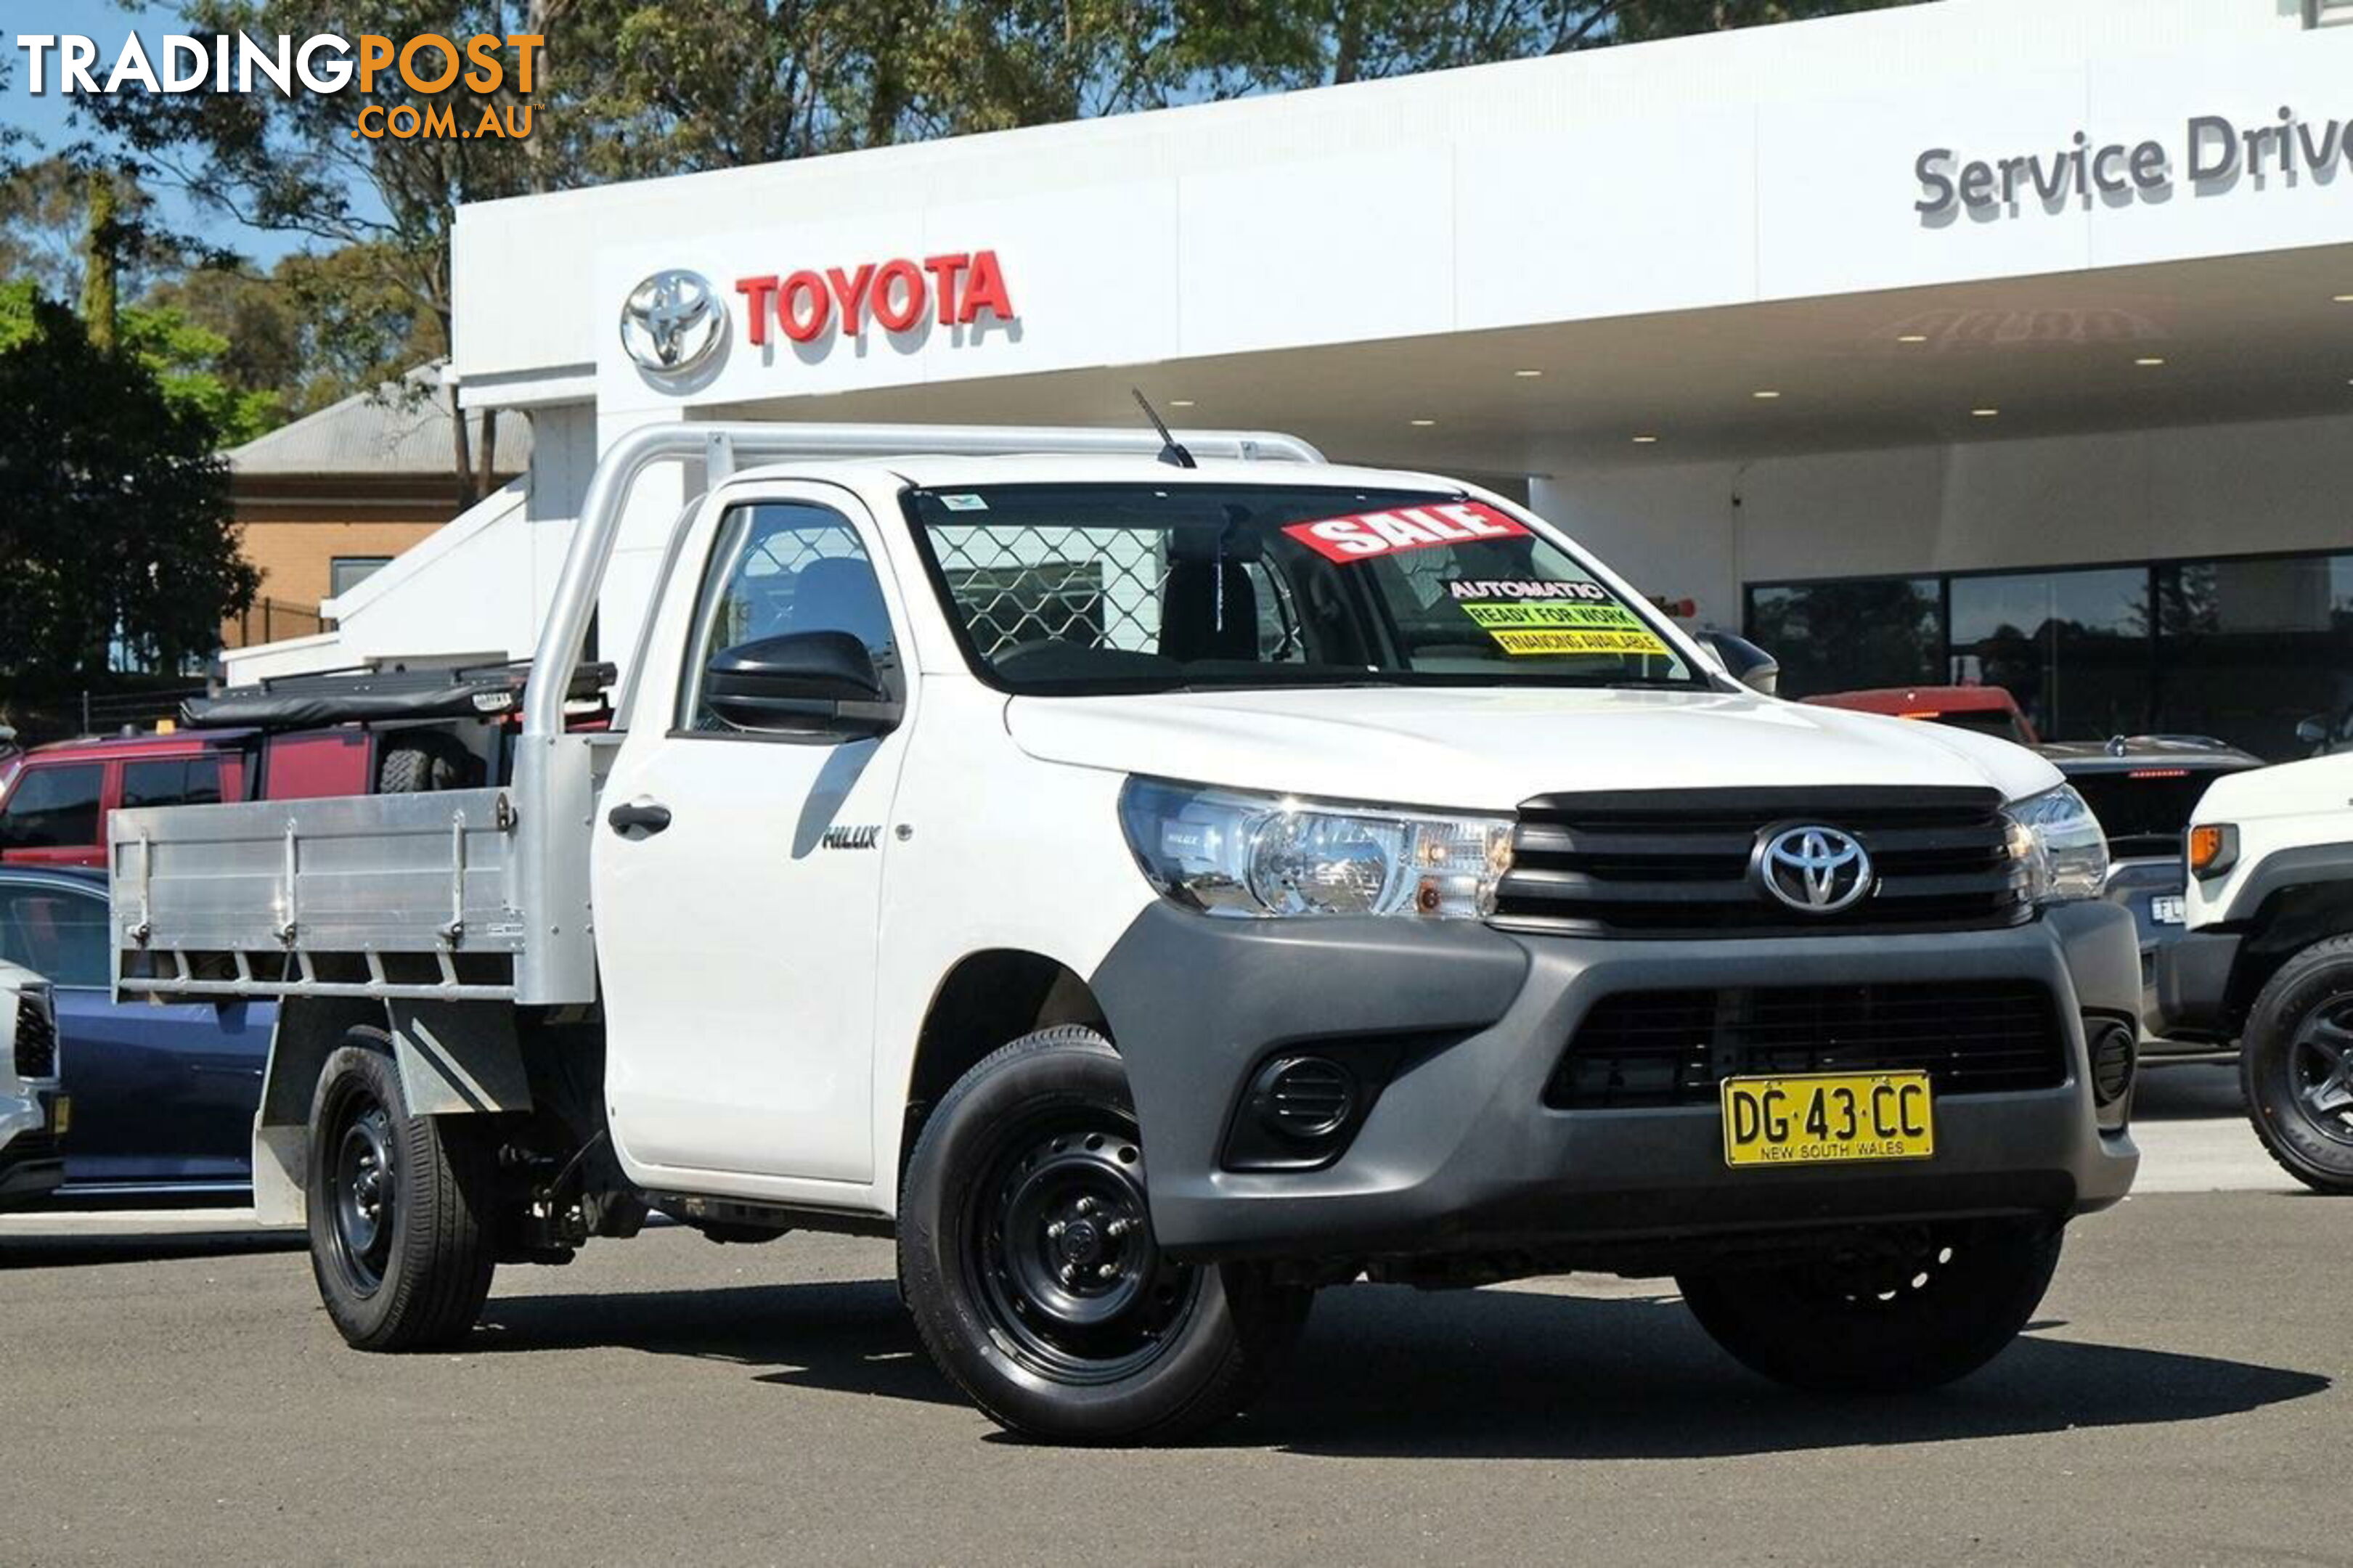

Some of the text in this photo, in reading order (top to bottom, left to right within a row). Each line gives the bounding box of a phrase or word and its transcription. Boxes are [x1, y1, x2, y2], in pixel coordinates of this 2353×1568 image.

[1914, 129, 2166, 213] Service
[735, 250, 1014, 346] TOYOTA
[1310, 505, 1510, 553] SALE
[1451, 581, 1604, 599] AUTOMATIC
[1469, 608, 1636, 625] READY FOR WORK
[1499, 634, 1662, 651] FINANCING AVAILABLE
[822, 825, 882, 850] HILUX
[1761, 1140, 1905, 1161] NEW SOUTH WALES
